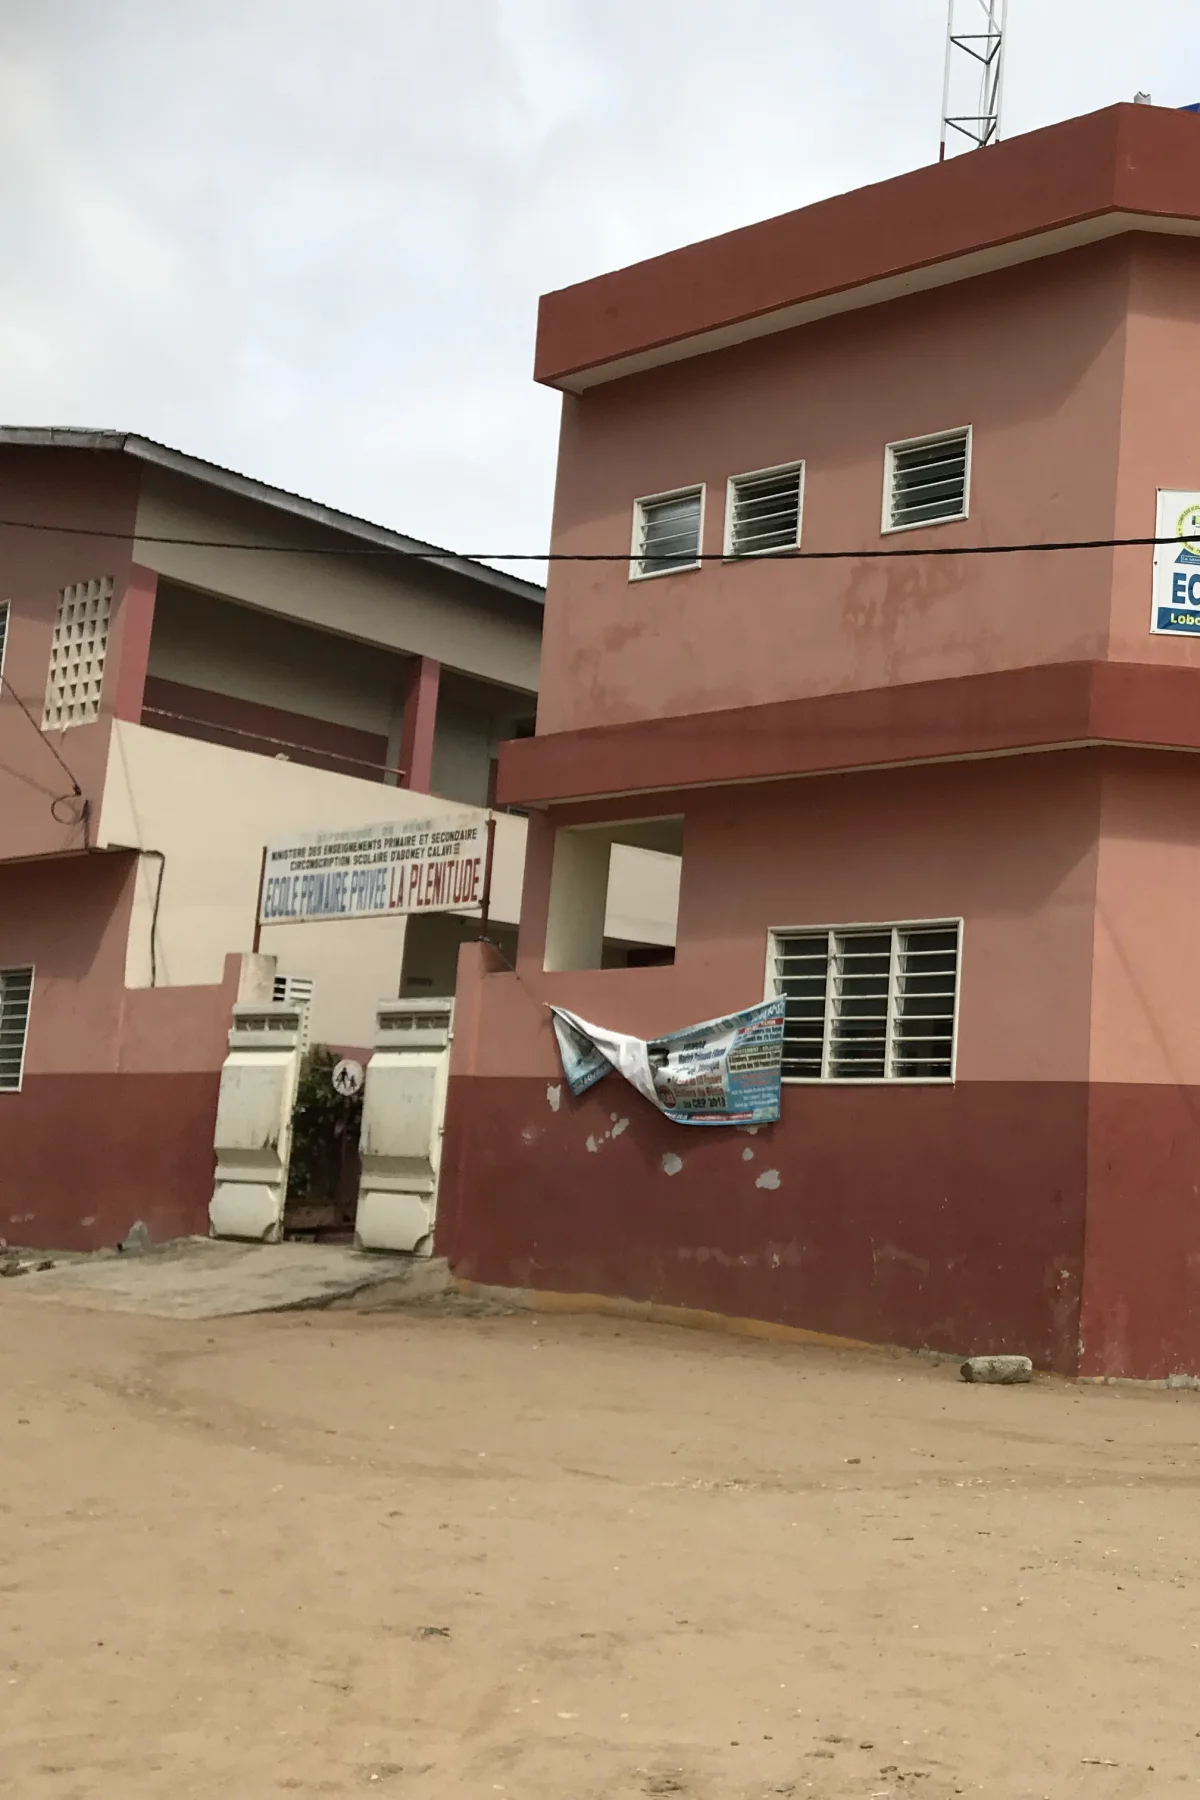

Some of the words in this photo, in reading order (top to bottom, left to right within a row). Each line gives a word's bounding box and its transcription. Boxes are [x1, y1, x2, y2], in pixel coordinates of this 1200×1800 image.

[271, 847, 306, 861] MINISTERE
[323, 838, 382, 855] ENSEIGNEMENTS
[384, 835, 416, 849] PRIMAIRE
[418, 833, 429, 843] ET
[431, 828, 478, 844] SECONDAIRE
[290, 855, 351, 871] CIRCONSCRIPTION
[353, 851, 388, 866] SCOLAIRE
[427, 844, 452, 858] CALAVI
[264, 875, 299, 918] ECOLE
[300, 871, 348, 915] PRIMAIRE
[349, 867, 388, 911] PRIVEE
[389, 864, 405, 909] LA
[408, 857, 481, 907] PLENITUDE
